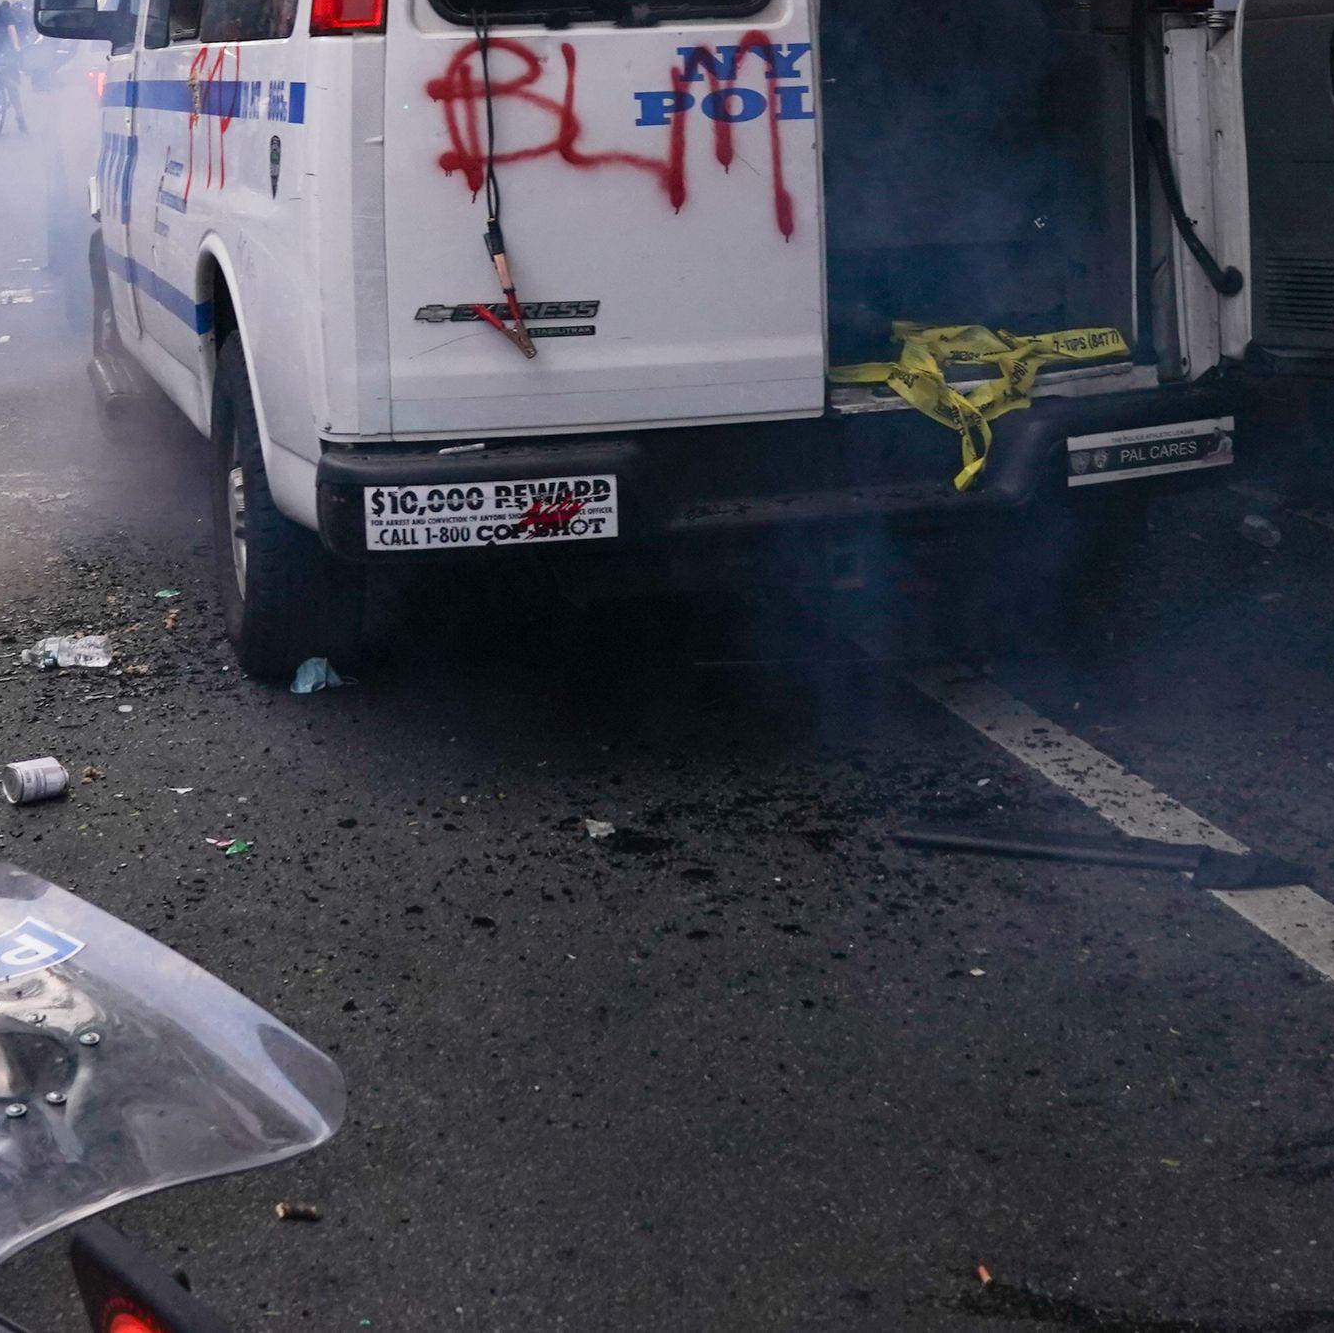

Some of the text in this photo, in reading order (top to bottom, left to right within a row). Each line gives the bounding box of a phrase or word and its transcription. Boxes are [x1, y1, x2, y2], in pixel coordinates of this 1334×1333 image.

[427, 29, 795, 242] BLM
[1120, 441, 1197, 463] PAL CARES
[371, 486, 484, 517] $10,000
[494, 479, 611, 510] REWARD
[371, 519, 384, 527] FOR
[386, 518, 410, 526] ARREST
[411, 517, 426, 526] AND
[427, 516, 468, 525] CONVICTION
[480, 513, 507, 522] ANYONE
[587, 506, 613, 515] OFFICER
[424, 526, 471, 545] 1-800
